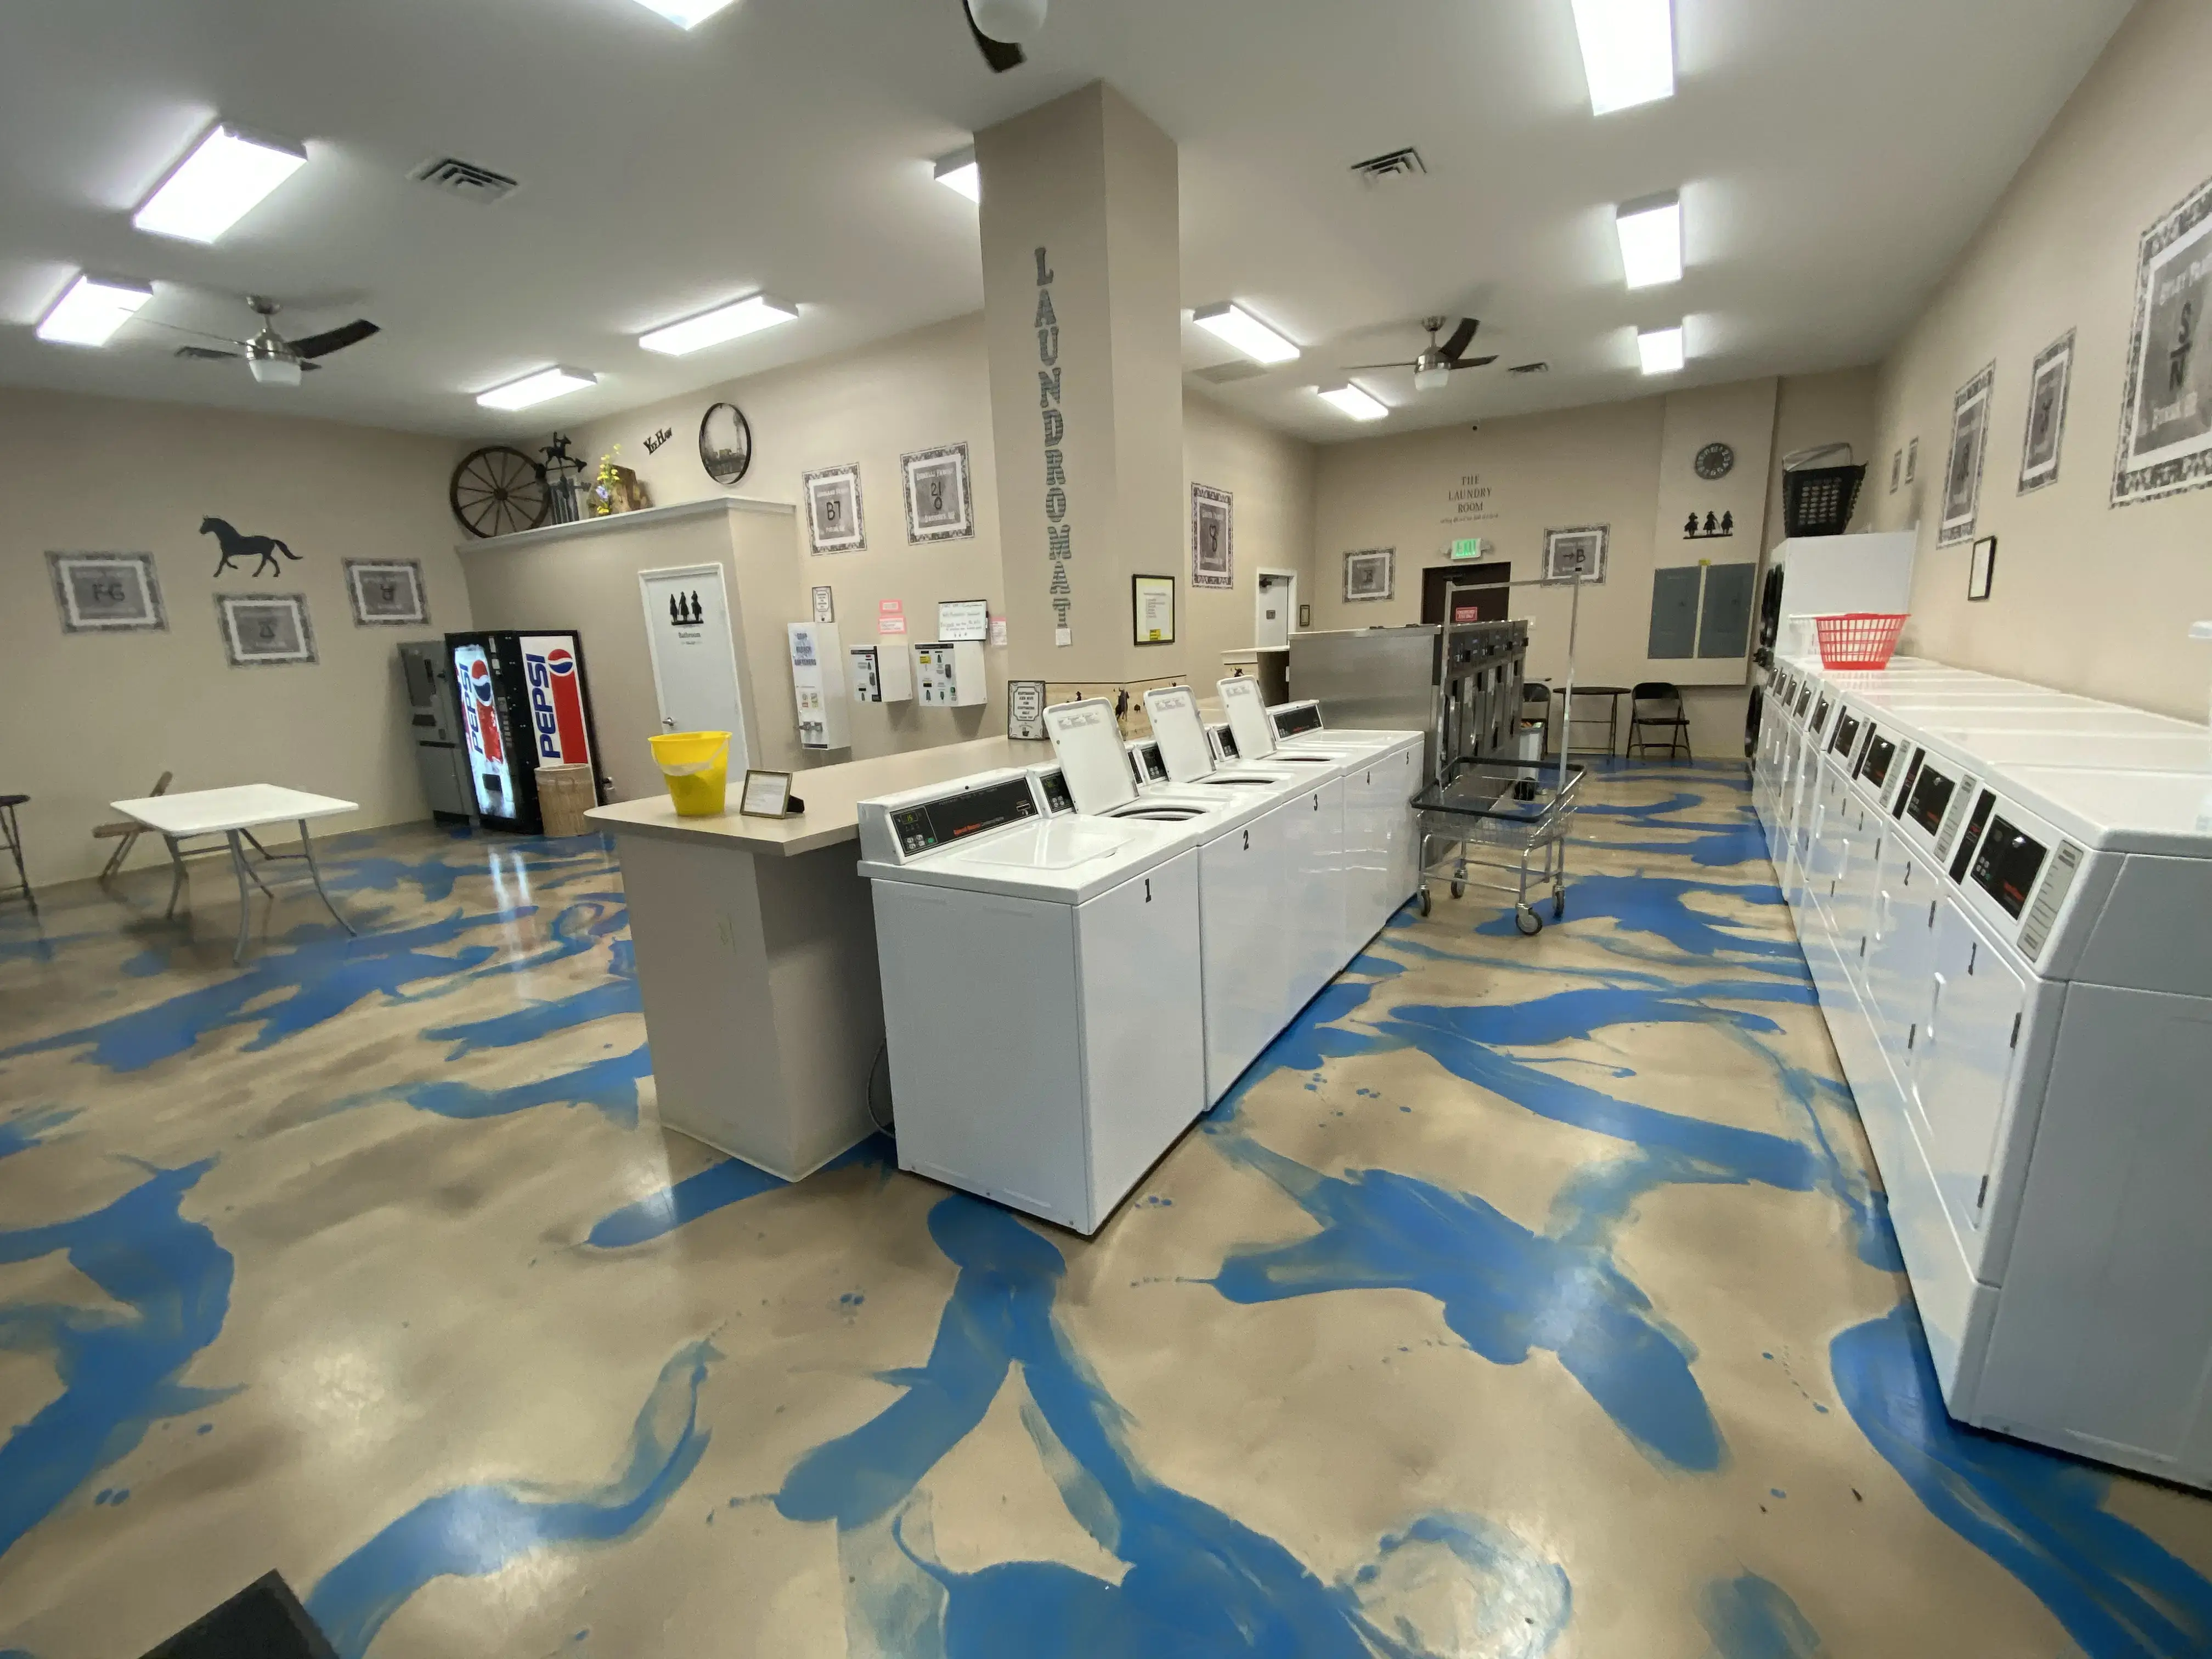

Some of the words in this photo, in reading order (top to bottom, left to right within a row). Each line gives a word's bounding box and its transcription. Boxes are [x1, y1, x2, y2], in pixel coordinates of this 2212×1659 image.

[1034, 246, 1071, 629] LAUNDROMAT
[1462, 473, 1480, 486] THE
[1448, 487, 1492, 501] LAUNDRY
[1458, 501, 1483, 513] ROOM
[459, 662, 483, 755] PEPSI
[526, 653, 561, 759] PEPSI
[1313, 794, 1318, 811] 3
[1243, 830, 1249, 851] 2
[1145, 878, 1152, 903] 1
